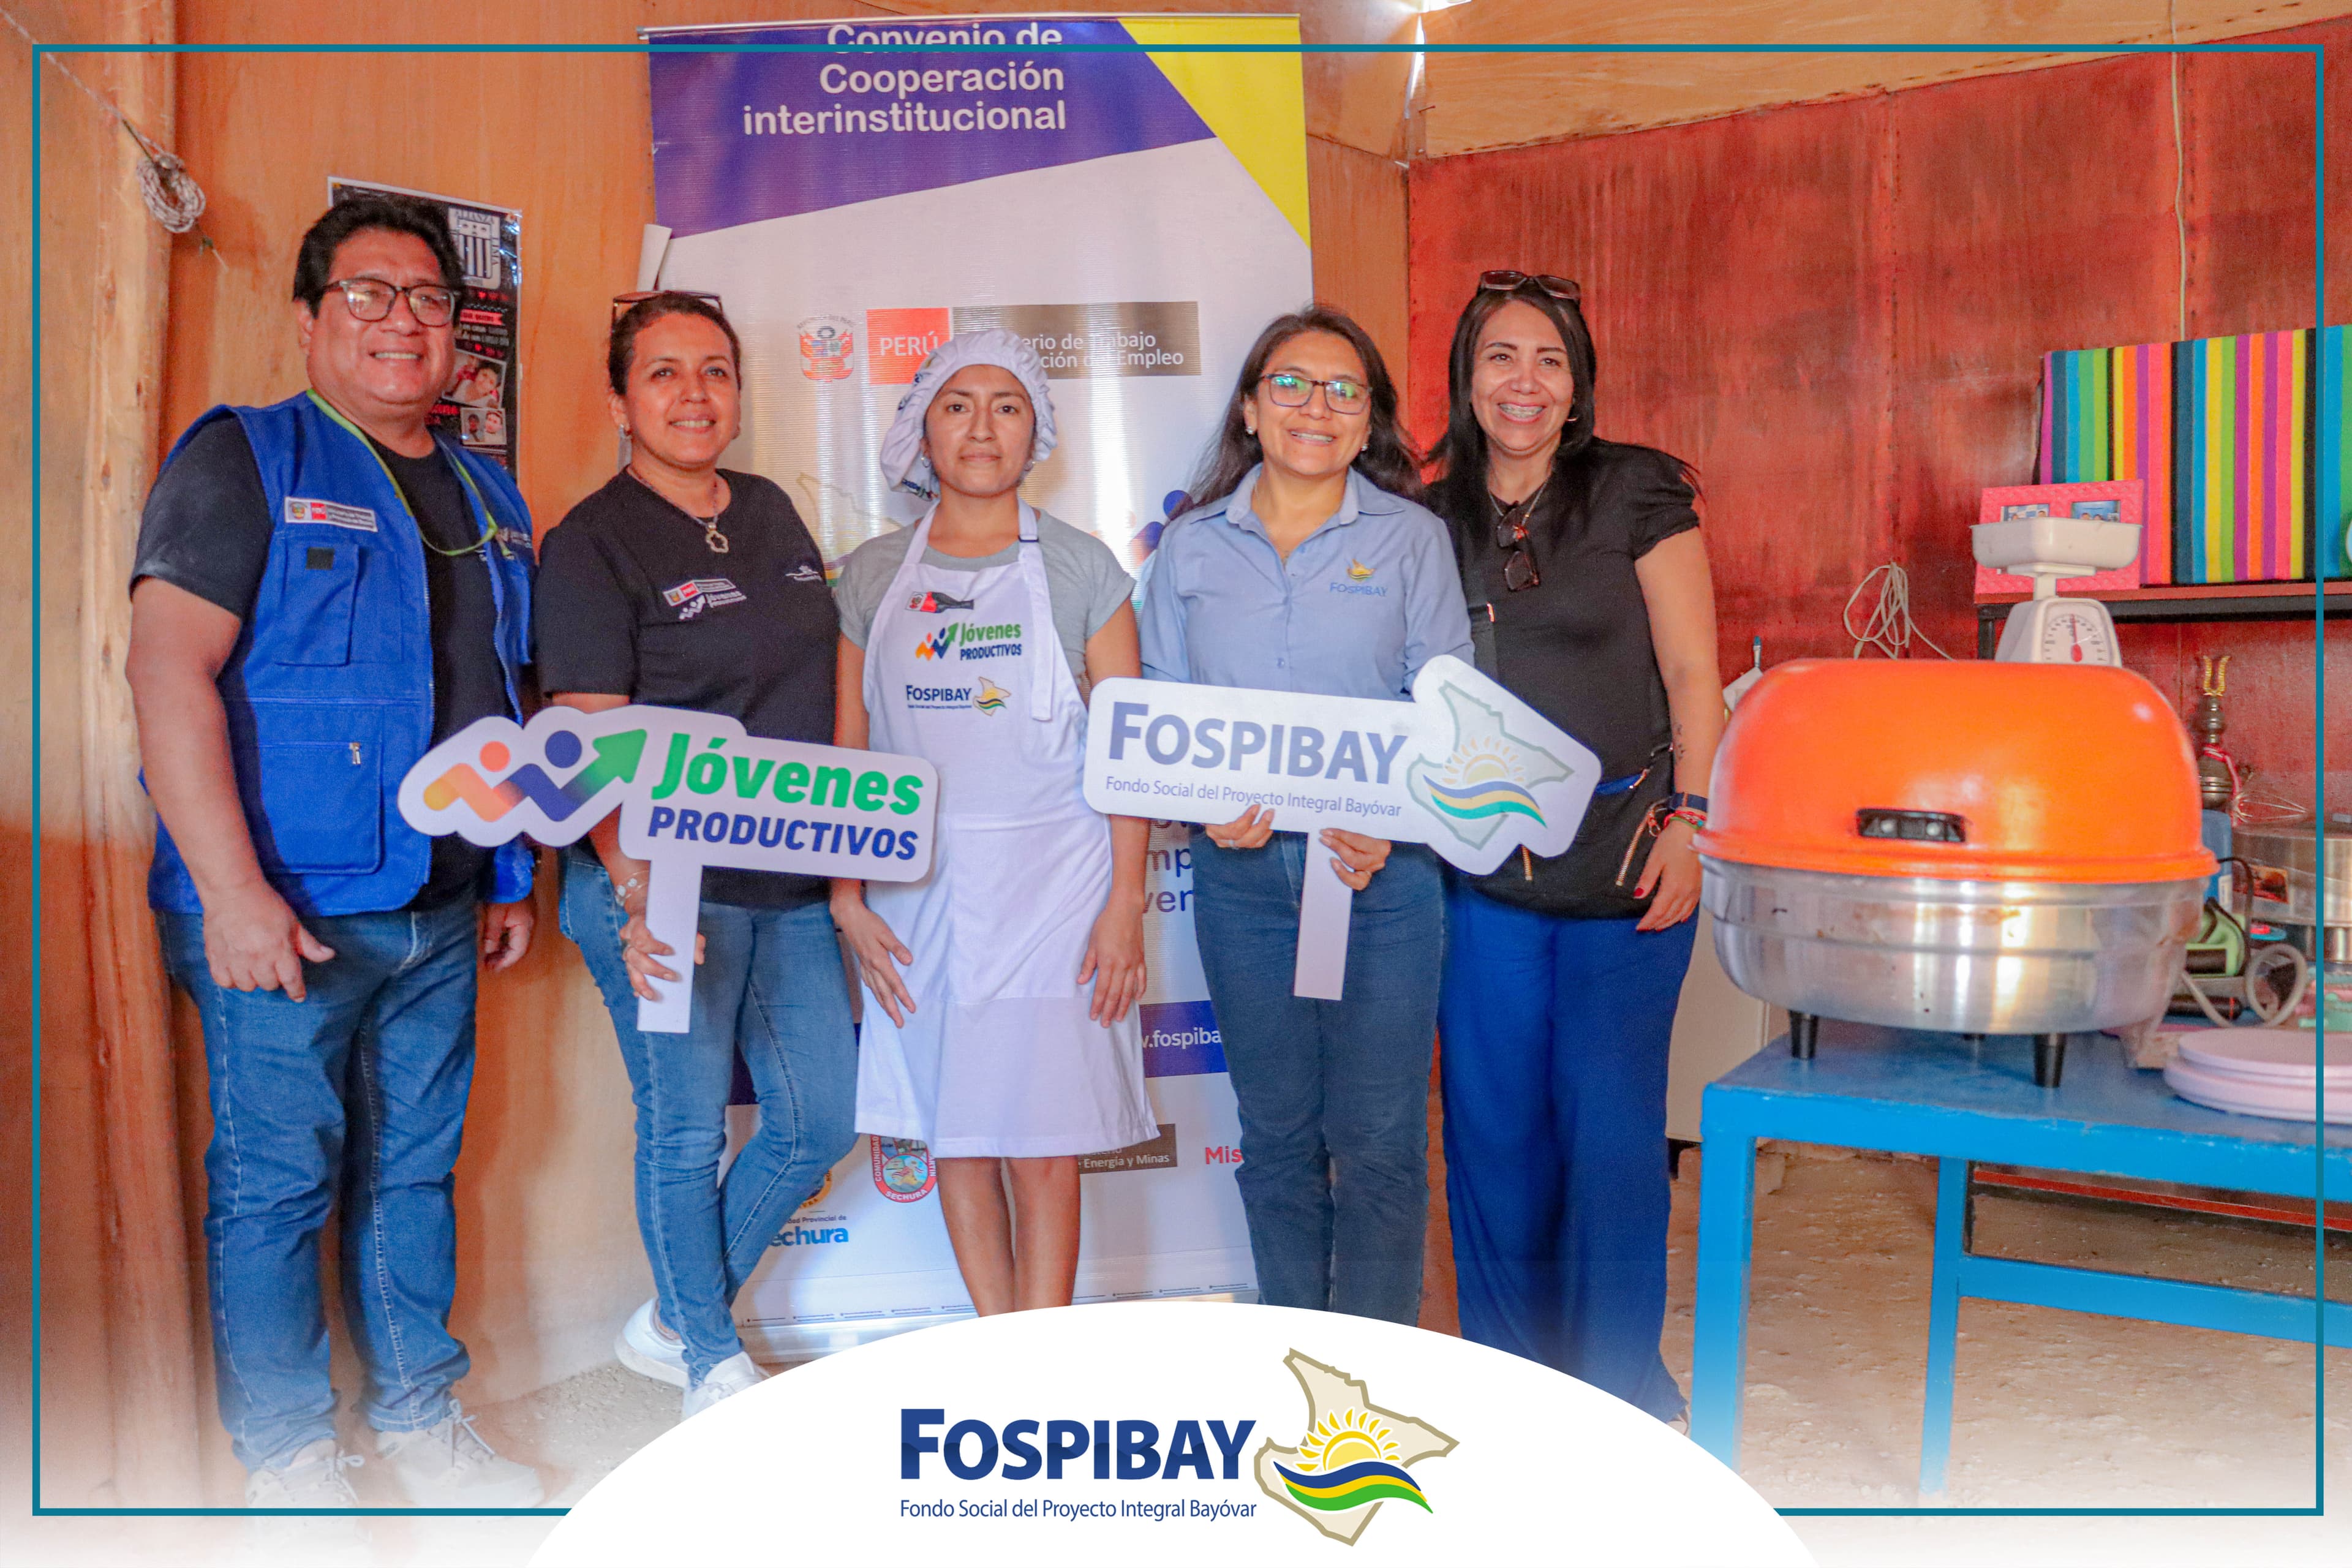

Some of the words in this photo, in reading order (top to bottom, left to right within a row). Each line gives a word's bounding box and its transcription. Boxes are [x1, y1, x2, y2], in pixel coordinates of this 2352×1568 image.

[827, 23, 1006, 53] Convenio
[1016, 22, 1063, 47] de
[820, 61, 1065, 99] Cooperación
[742, 100, 1066, 135] interinstitucional
[880, 331, 938, 356] PERÚ
[1023, 334, 1056, 350] erio
[1061, 333, 1084, 349] de
[1041, 350, 1077, 368] ción
[1117, 348, 1184, 369] Empleo
[1330, 582, 1388, 597] FOSPIBAY
[959, 622, 1022, 647] Jóvenes
[960, 643, 1022, 661] PRODUCTIVOS
[905, 685, 972, 702] FOSPIBAY
[1108, 701, 1408, 785] FOSPIBAY
[651, 732, 924, 815] Jóvenes
[1106, 776, 1150, 794] Fondo
[1153, 780, 1194, 798] Social
[1197, 785, 1219, 800] del
[1223, 787, 1284, 807] Proyecto
[1287, 793, 1341, 813] Integral
[1346, 798, 1401, 818] Bayóvar
[648, 806, 919, 861] PRODUCTIVOS
[1127, 1157, 1134, 1167] y
[1136, 1153, 1170, 1165] Minas
[885, 1188, 928, 1200] SECHURA
[770, 1226, 849, 1246] echura
